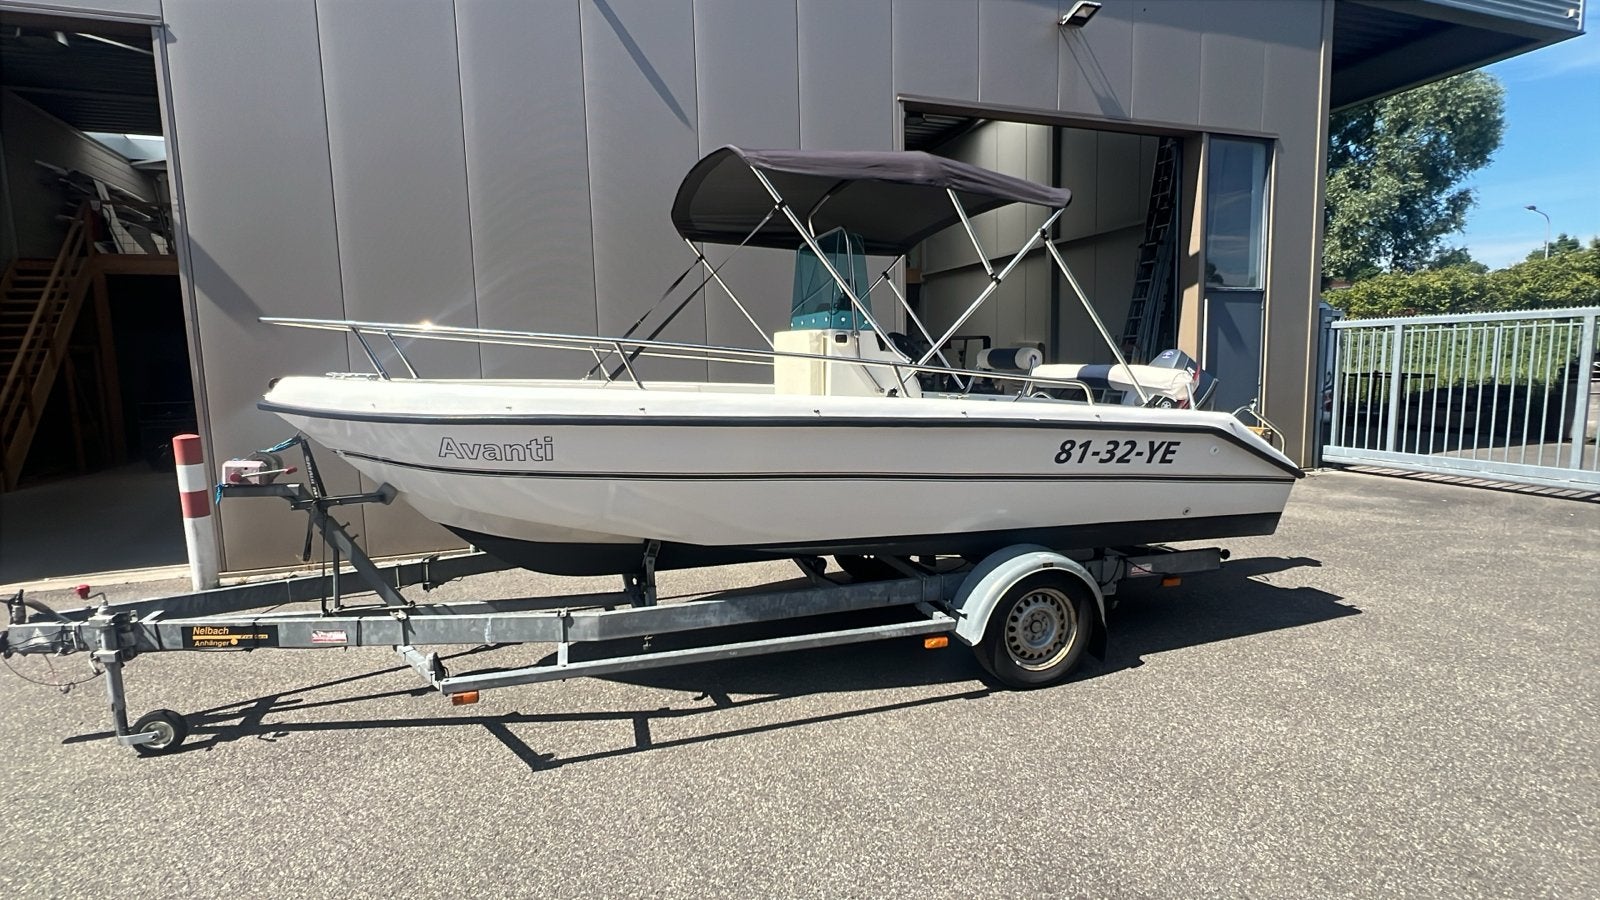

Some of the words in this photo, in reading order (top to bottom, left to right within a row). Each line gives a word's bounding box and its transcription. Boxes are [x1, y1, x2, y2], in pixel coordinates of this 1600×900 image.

[438, 436, 554, 461] Avanti
[1054, 439, 1181, 464] 81-32-YE
[192, 626, 229, 635] Nelbach
